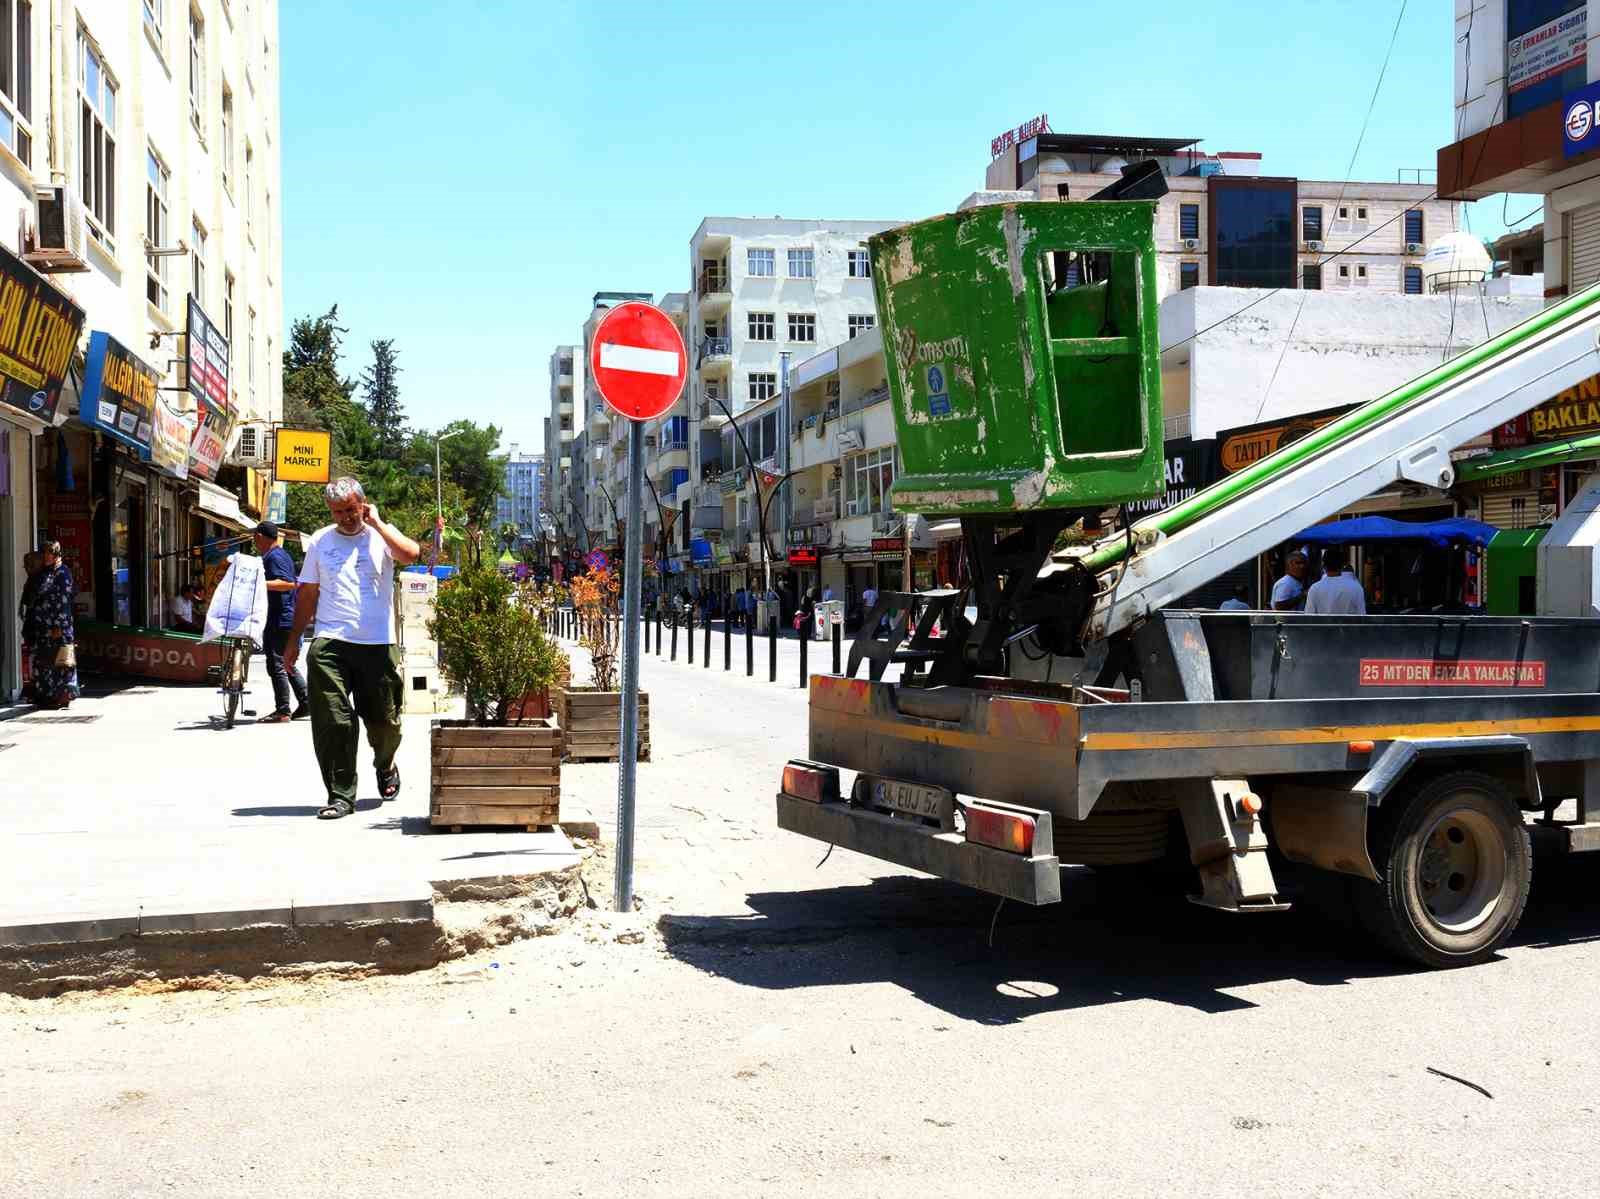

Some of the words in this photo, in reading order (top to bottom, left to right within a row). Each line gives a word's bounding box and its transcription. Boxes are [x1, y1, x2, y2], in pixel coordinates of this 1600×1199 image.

[1534, 401, 1600, 432] BAKLA
[293, 446, 314, 455] MINI
[284, 456, 322, 467] MARKET
[1363, 665, 1379, 680] 25
[1383, 665, 1431, 680] MT'DEN
[1434, 666, 1470, 681] FAZLA
